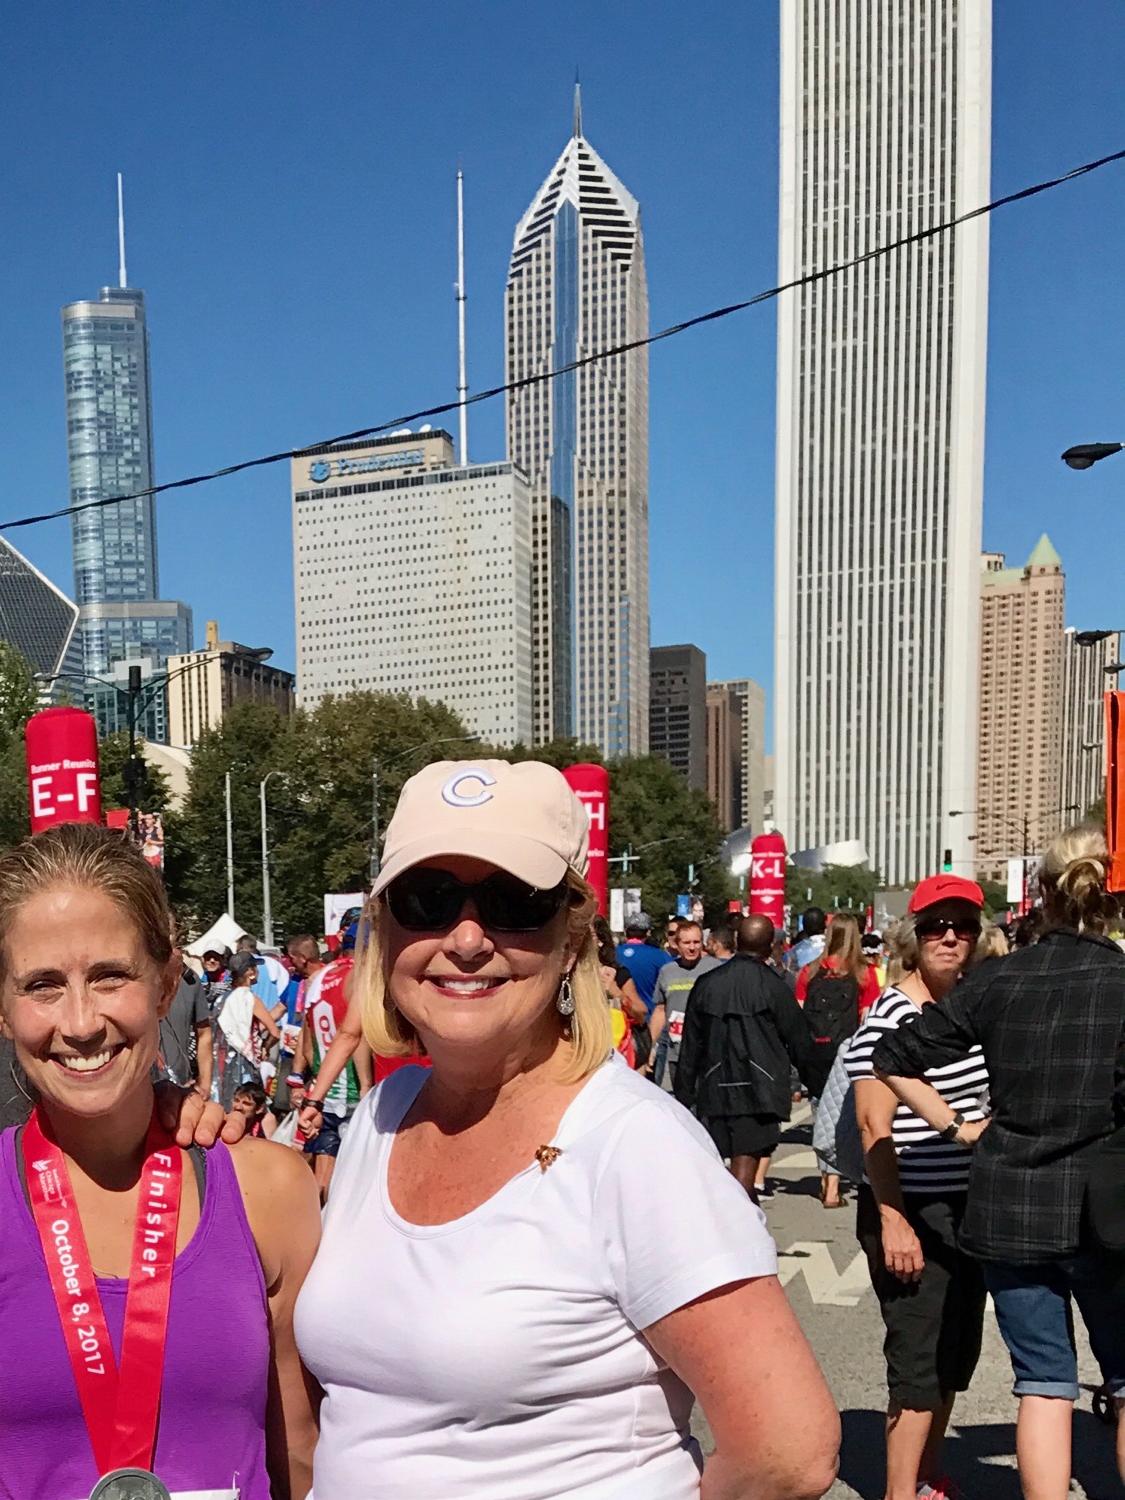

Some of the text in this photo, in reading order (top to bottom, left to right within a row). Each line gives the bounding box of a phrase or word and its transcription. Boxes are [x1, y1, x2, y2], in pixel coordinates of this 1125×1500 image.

[31, 759, 96, 774] Runner Reunite
[441, 767, 497, 807] C
[32, 773, 97, 818] E-F
[752, 860, 785, 878] K-L
[141, 1152, 172, 1278] Finisher
[51, 1219, 105, 1376] October 8, 2017
